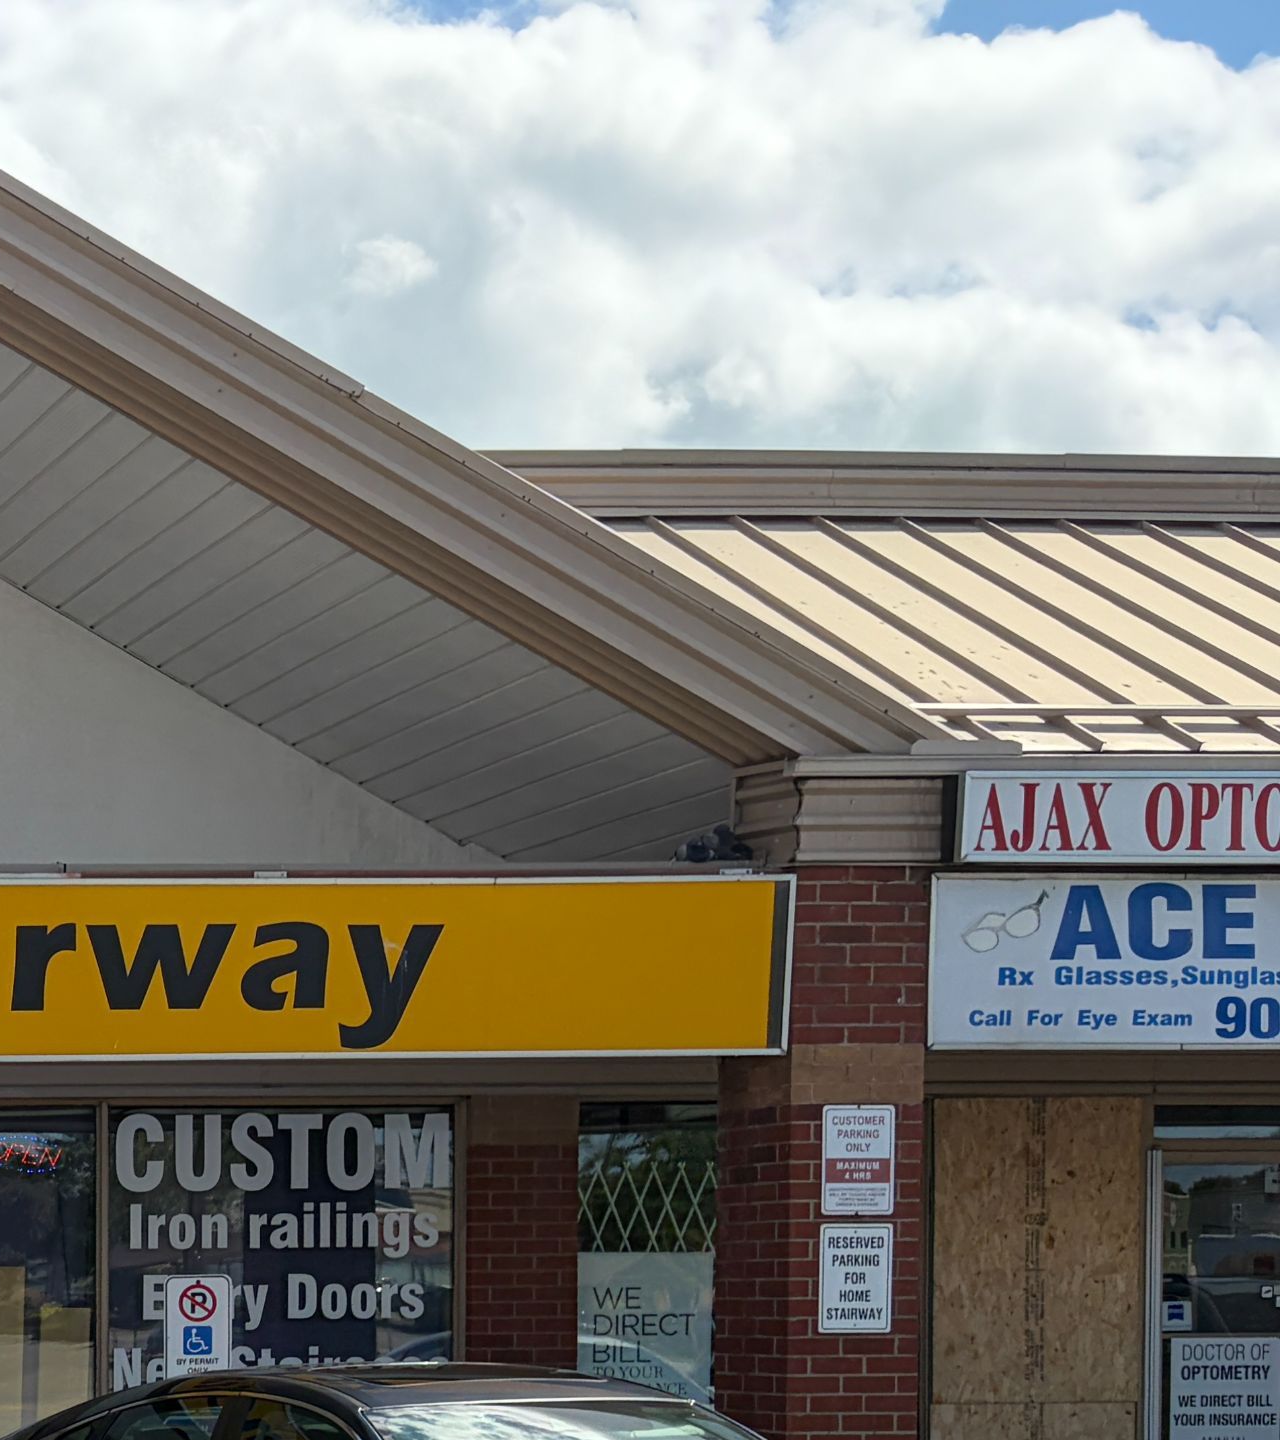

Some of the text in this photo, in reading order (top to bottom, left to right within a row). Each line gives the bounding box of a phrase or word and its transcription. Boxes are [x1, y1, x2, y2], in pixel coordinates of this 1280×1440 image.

[973, 782, 1113, 853] AJAX
[1049, 882, 1257, 961] ACE
[997, 967, 1035, 986] Rx
[968, 996, 1280, 1040] Call For Eye Exam 90
[832, 1115, 886, 1126] CUSTOMER
[837, 1129, 880, 1140] PARKING
[115, 1112, 451, 1193] CUSTOM
[845, 1143, 872, 1153] ONLY
[836, 1161, 880, 1170] MAXIMUM
[844, 1171, 872, 1180] 4 HRS
[129, 1202, 440, 1259] Iron railings
[827, 1236, 885, 1249] RESERVED
[832, 1254, 881, 1267] PARKING
[844, 1272, 867, 1285] FOR
[593, 1286, 642, 1310] WE
[839, 1289, 871, 1302] HOME
[142, 1273, 425, 1332] Ery Doors
[826, 1307, 883, 1320] STAIRWAY
[593, 1313, 696, 1336] DIRECT
[592, 1341, 652, 1363] BILL
[1182, 1344, 1271, 1361] DOCTOR OF
[176, 1358, 187, 1366] BY
[113, 1347, 165, 1393] Ne
[593, 1366, 664, 1379] TO YOUR
[1181, 1365, 1271, 1381] OPTOMETRY
[1178, 1394, 1273, 1407] WE DIRECT BILL
[1173, 1413, 1278, 1426] YOUR INSURANCE
